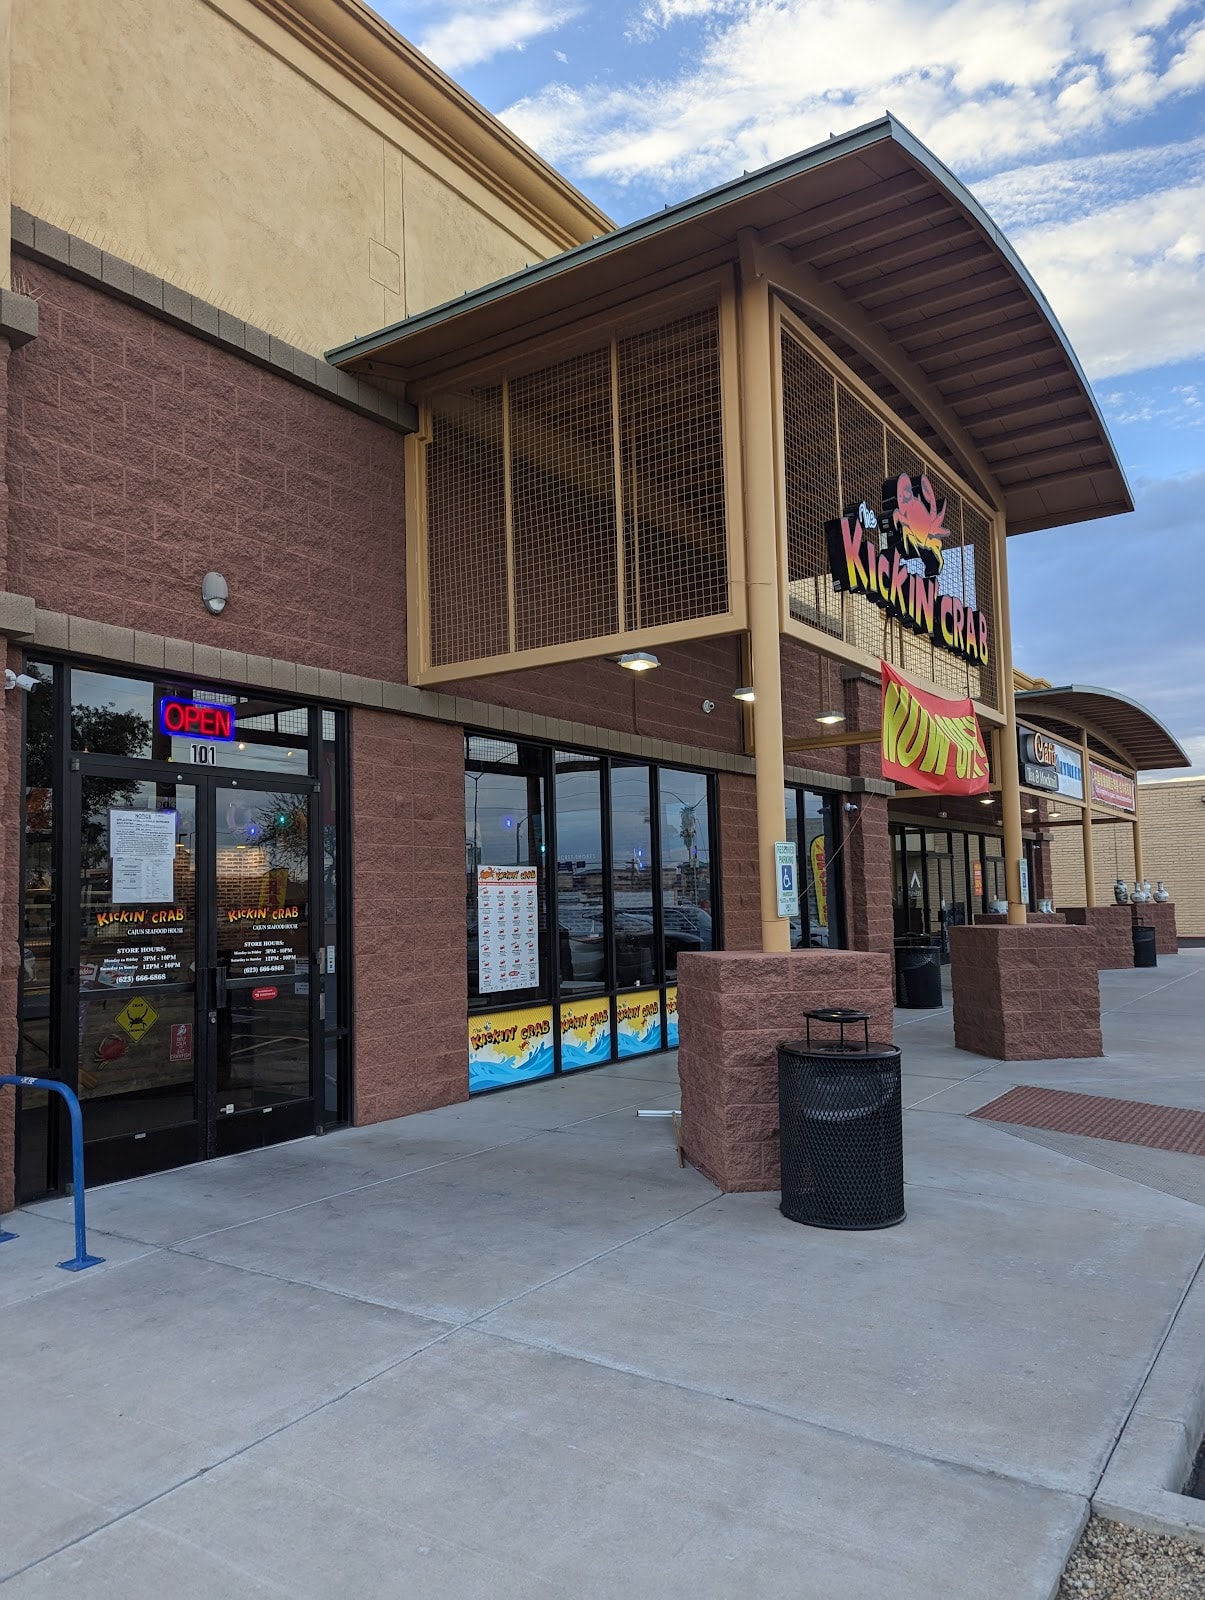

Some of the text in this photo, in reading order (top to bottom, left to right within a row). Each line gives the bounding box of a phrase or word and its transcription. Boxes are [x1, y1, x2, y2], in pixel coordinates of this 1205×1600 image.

[940, 594, 988, 666] CRAB
[165, 703, 231, 737] OPEN
[883, 679, 951, 776] NOW
[191, 744, 215, 765] 101
[96, 908, 184, 927] KICKIN' CRAB
[227, 906, 299, 922] KICKIN' CRAB
[116, 973, 167, 985] (623) 666-6868
[589, 1009, 609, 1027] CRAB
[642, 1001, 659, 1017] CRAB
[520, 1020, 551, 1040] CRAB
